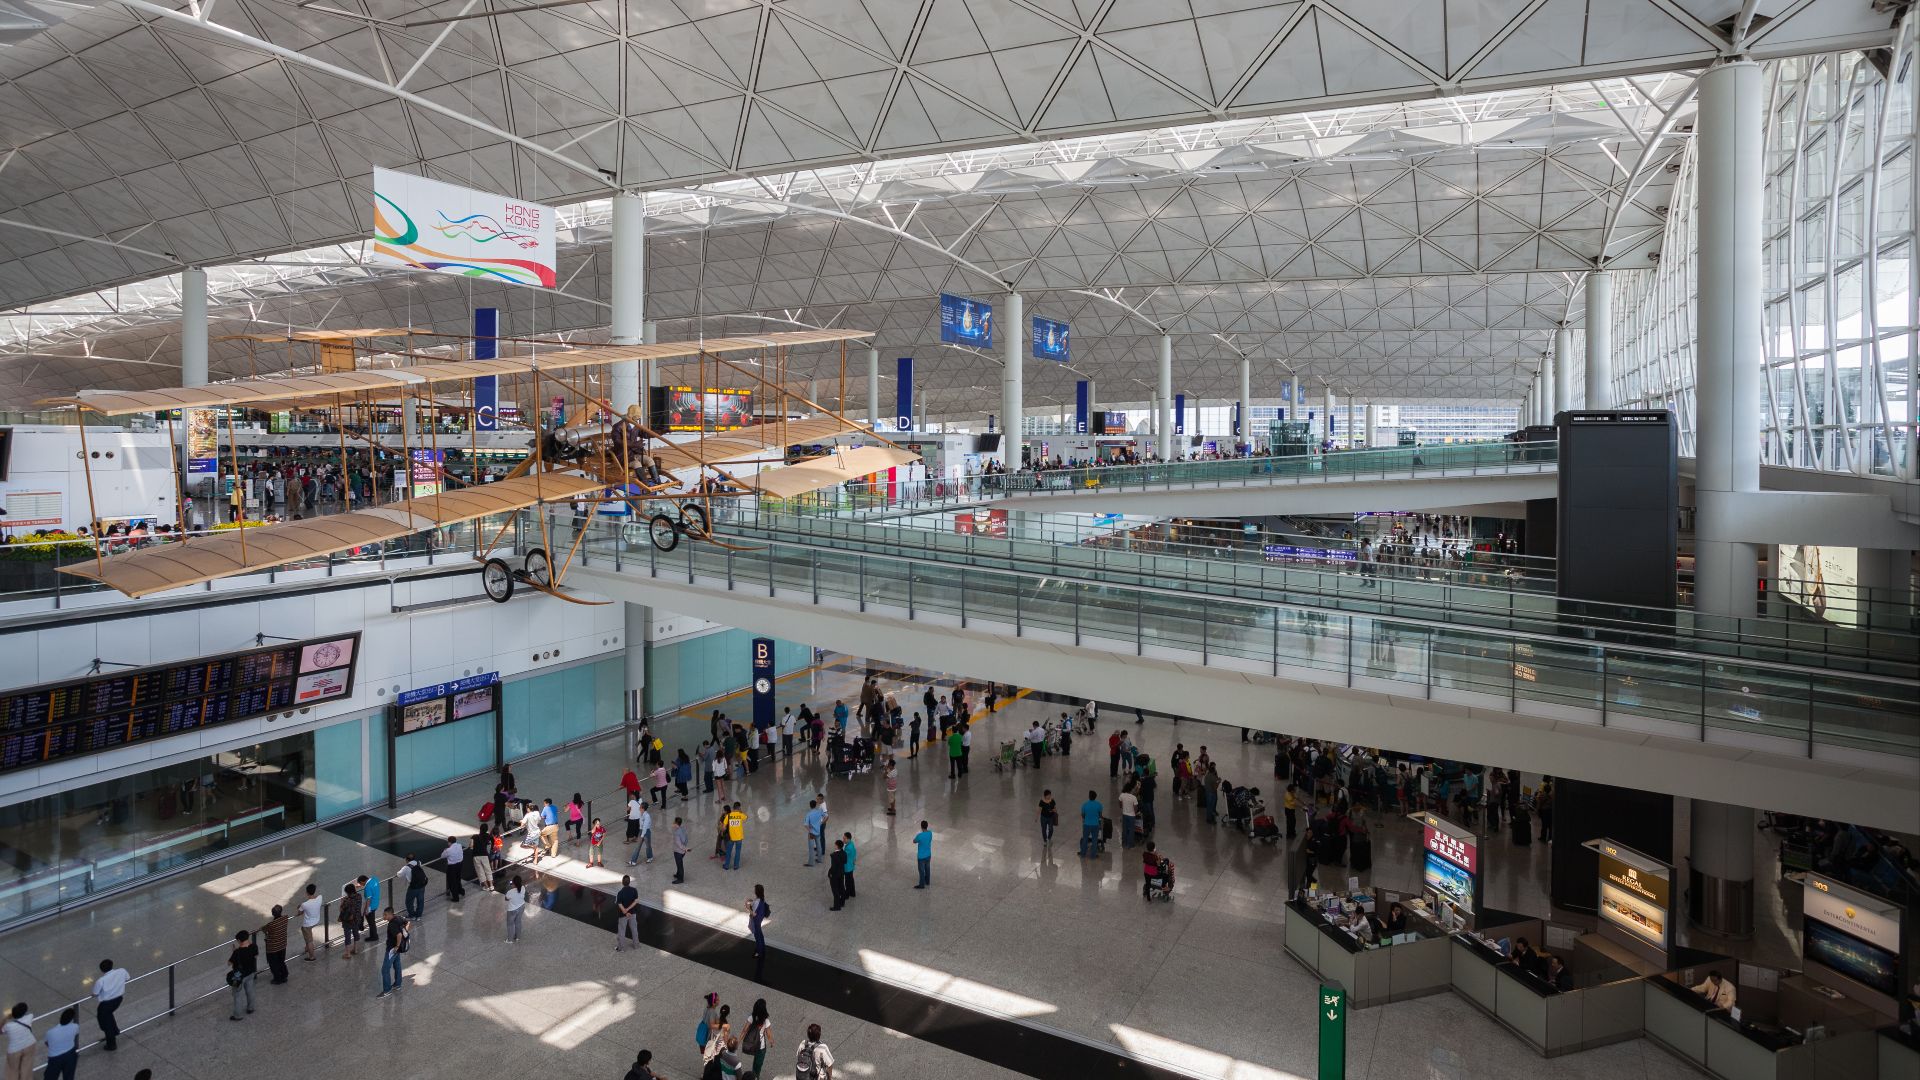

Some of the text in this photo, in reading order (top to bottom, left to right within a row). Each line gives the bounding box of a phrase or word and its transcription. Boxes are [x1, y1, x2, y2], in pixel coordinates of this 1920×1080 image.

[505, 203, 539, 219] HONG
[505, 214, 539, 229] KONG
[478, 405, 493, 426] C
[899, 416, 910, 429] D
[1078, 422, 1085, 431] E
[1176, 426, 1182, 434] F
[1824, 560, 1843, 573] ZENITH
[757, 644, 768, 659] B
[490, 672, 498, 684] A
[437, 684, 444, 696] B
[1622, 875, 1643, 889] REGAL
[1812, 880, 1828, 892] B03
